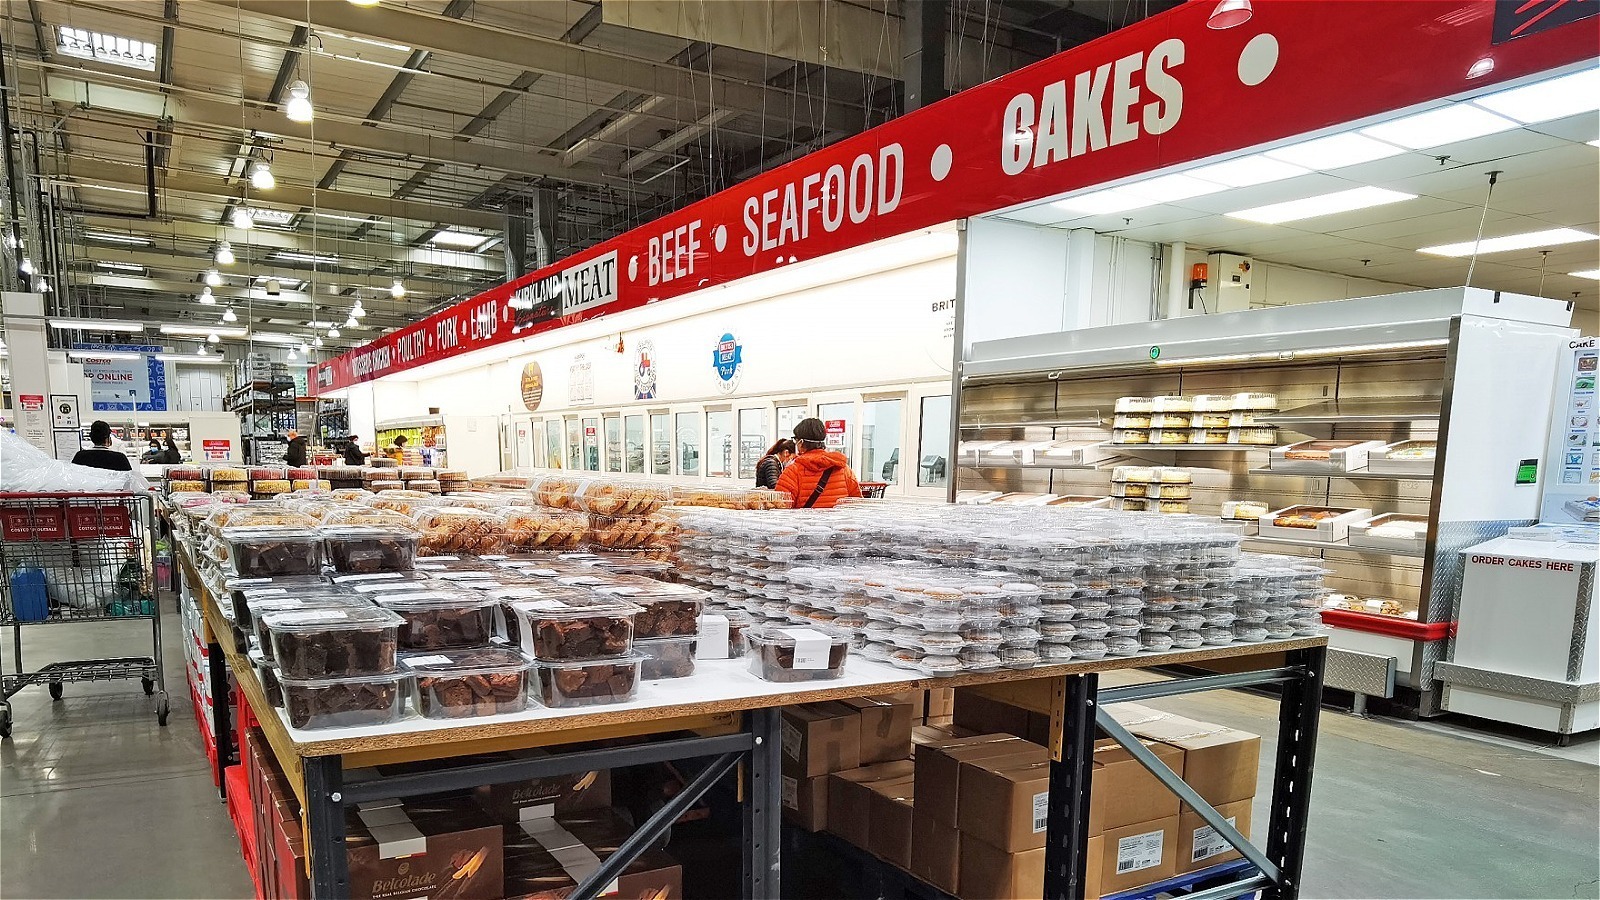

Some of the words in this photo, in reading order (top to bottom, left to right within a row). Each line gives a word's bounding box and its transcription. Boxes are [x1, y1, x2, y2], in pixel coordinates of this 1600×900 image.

[397, 328, 426, 363] POULTRY
[436, 315, 459, 352] PORK
[470, 300, 498, 340] LAMB
[515, 274, 560, 310] KIRKLAND
[564, 257, 615, 309] MEAT
[648, 219, 702, 287] BEEF
[742, 142, 904, 257] SEAFOOD
[1001, 38, 1185, 176] CAKES
[1569, 340, 1595, 349] CAKE
[97, 373, 133, 381] ONLINE
[1471, 555, 1504, 566] ORDER
[1508, 558, 1542, 569] CAKES
[1546, 561, 1574, 572] HERE
[372, 871, 436, 893] Belcolade
